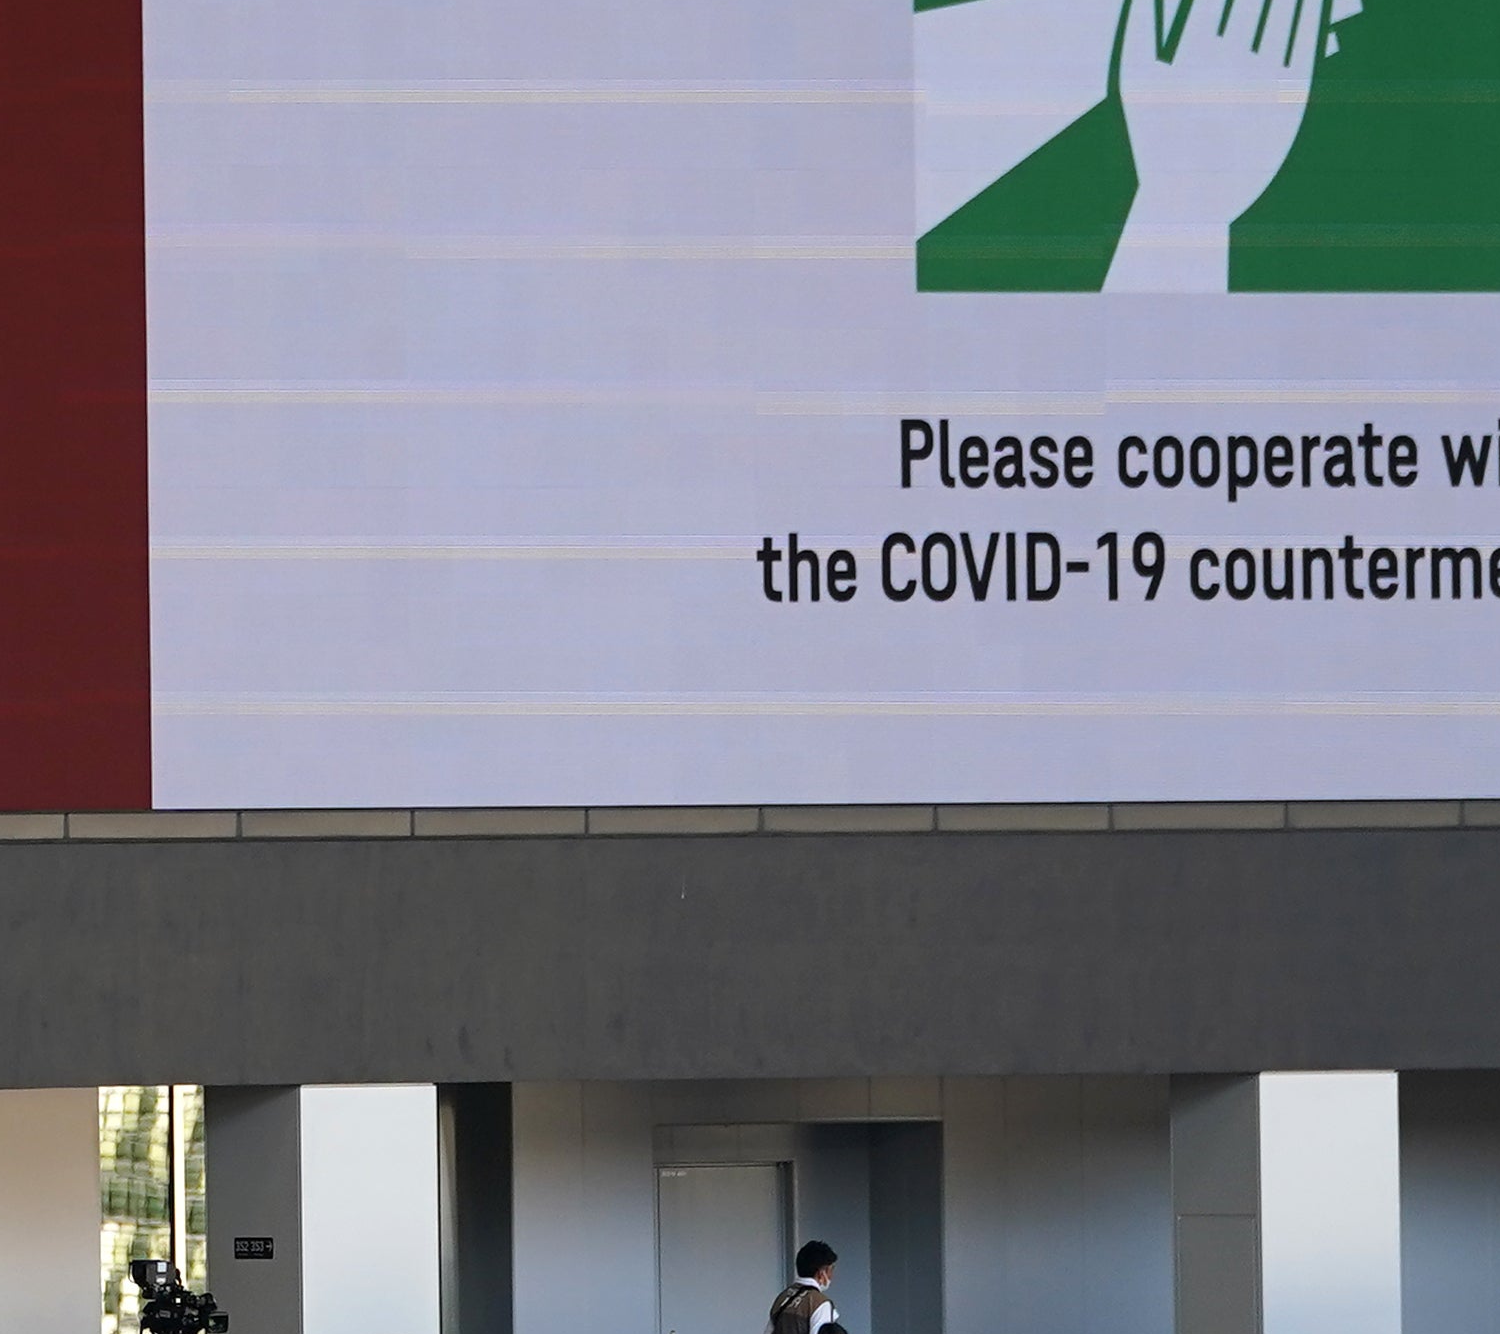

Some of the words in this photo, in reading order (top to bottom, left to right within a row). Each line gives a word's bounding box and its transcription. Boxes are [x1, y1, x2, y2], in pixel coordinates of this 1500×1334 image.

[901, 419, 1093, 489] Please
[1118, 422, 1418, 504] cooperate
[757, 533, 857, 603] the
[882, 531, 1166, 603] COVID-19
